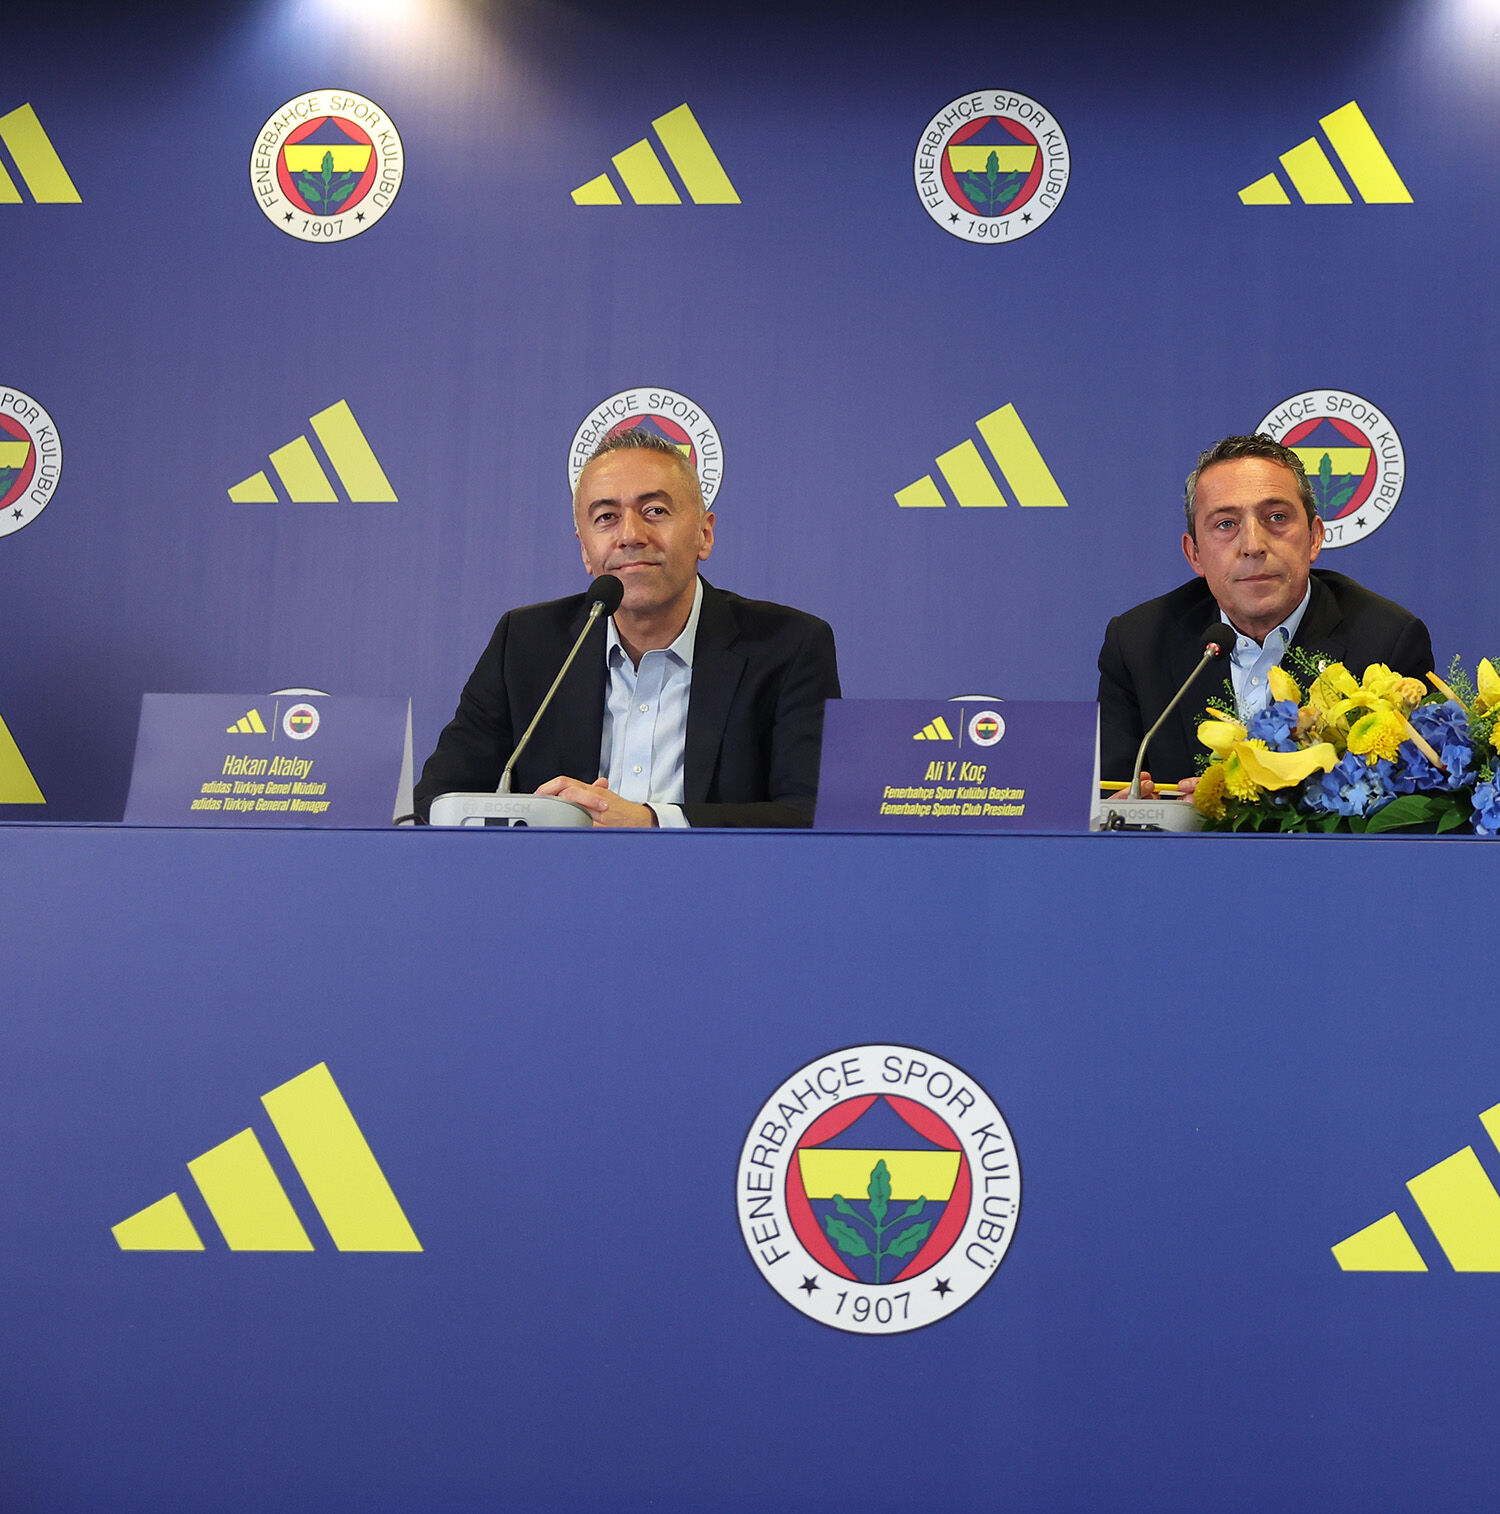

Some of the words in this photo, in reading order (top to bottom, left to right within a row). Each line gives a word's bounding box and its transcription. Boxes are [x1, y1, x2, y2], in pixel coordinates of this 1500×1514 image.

[256, 97, 320, 208] FENERBAHÇE
[330, 95, 381, 128] SPOR
[372, 129, 400, 208] KULÜBÜ
[919, 96, 985, 209] FENERBAHÇE
[993, 95, 1046, 128] SPOR
[1039, 129, 1067, 209] KULÜBÜ
[302, 219, 343, 237] 1907
[967, 220, 1010, 238] 1907
[0, 392, 40, 425] POR
[30, 425, 60, 505] KULÜBÜ
[573, 394, 639, 482] ERBAHÇE
[648, 393, 700, 428] SPOR
[696, 428, 721, 507] KULÜB
[1325, 395, 1380, 431] SPOR
[1373, 431, 1402, 513] KULÜBÜ
[1324, 525, 1344, 543] 07
[222, 755, 268, 776] Hakan
[268, 755, 314, 779] Atalay
[925, 761, 945, 781] Ali
[946, 761, 956, 781] Y.
[958, 761, 987, 784] Koç
[200, 781, 231, 794] adidas
[232, 781, 264, 796] Türkiye
[266, 781, 290, 795] Genel
[291, 782, 326, 796] Müdürü
[883, 785, 934, 801] Fenerbahçe
[935, 786, 956, 801] Spor
[956, 786, 988, 800] Kulübü
[988, 787, 1024, 802] Başkanı
[190, 798, 221, 810] adidas
[222, 798, 254, 812] Türkiye
[255, 798, 289, 811] General
[290, 799, 331, 814] Manager
[484, 802, 531, 814] BOSCH
[880, 802, 931, 817] Fenerbahçe
[932, 803, 960, 817] Sports
[961, 803, 981, 816] Club
[982, 803, 1025, 816] President
[1120, 808, 1165, 819] BOSCH
[746, 1057, 865, 1267] FENERBAHÇE
[881, 1055, 976, 1119] SPOR
[965, 1122, 1016, 1270] KULÜBÜ
[834, 1290, 911, 1324] 1907
